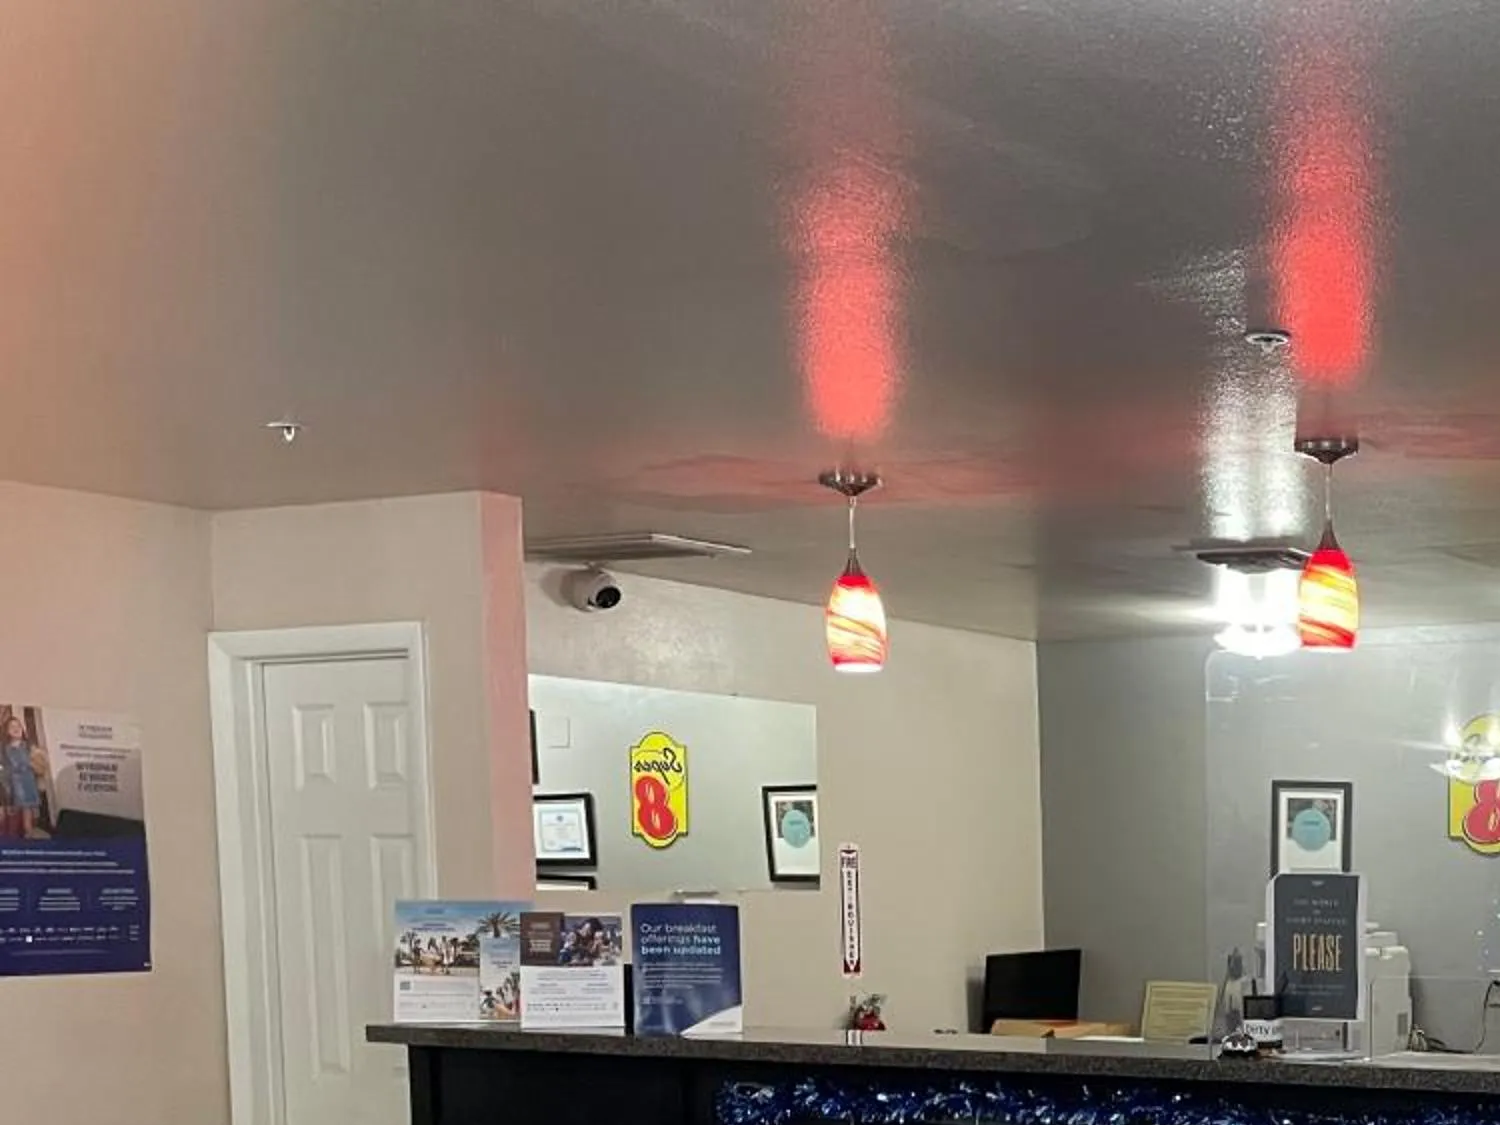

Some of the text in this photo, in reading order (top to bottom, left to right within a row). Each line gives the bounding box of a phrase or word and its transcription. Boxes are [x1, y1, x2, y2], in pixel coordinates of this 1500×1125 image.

[640, 923, 661, 933] Our
[641, 946, 671, 955] been
[1292, 933, 1344, 972] PLEASE
